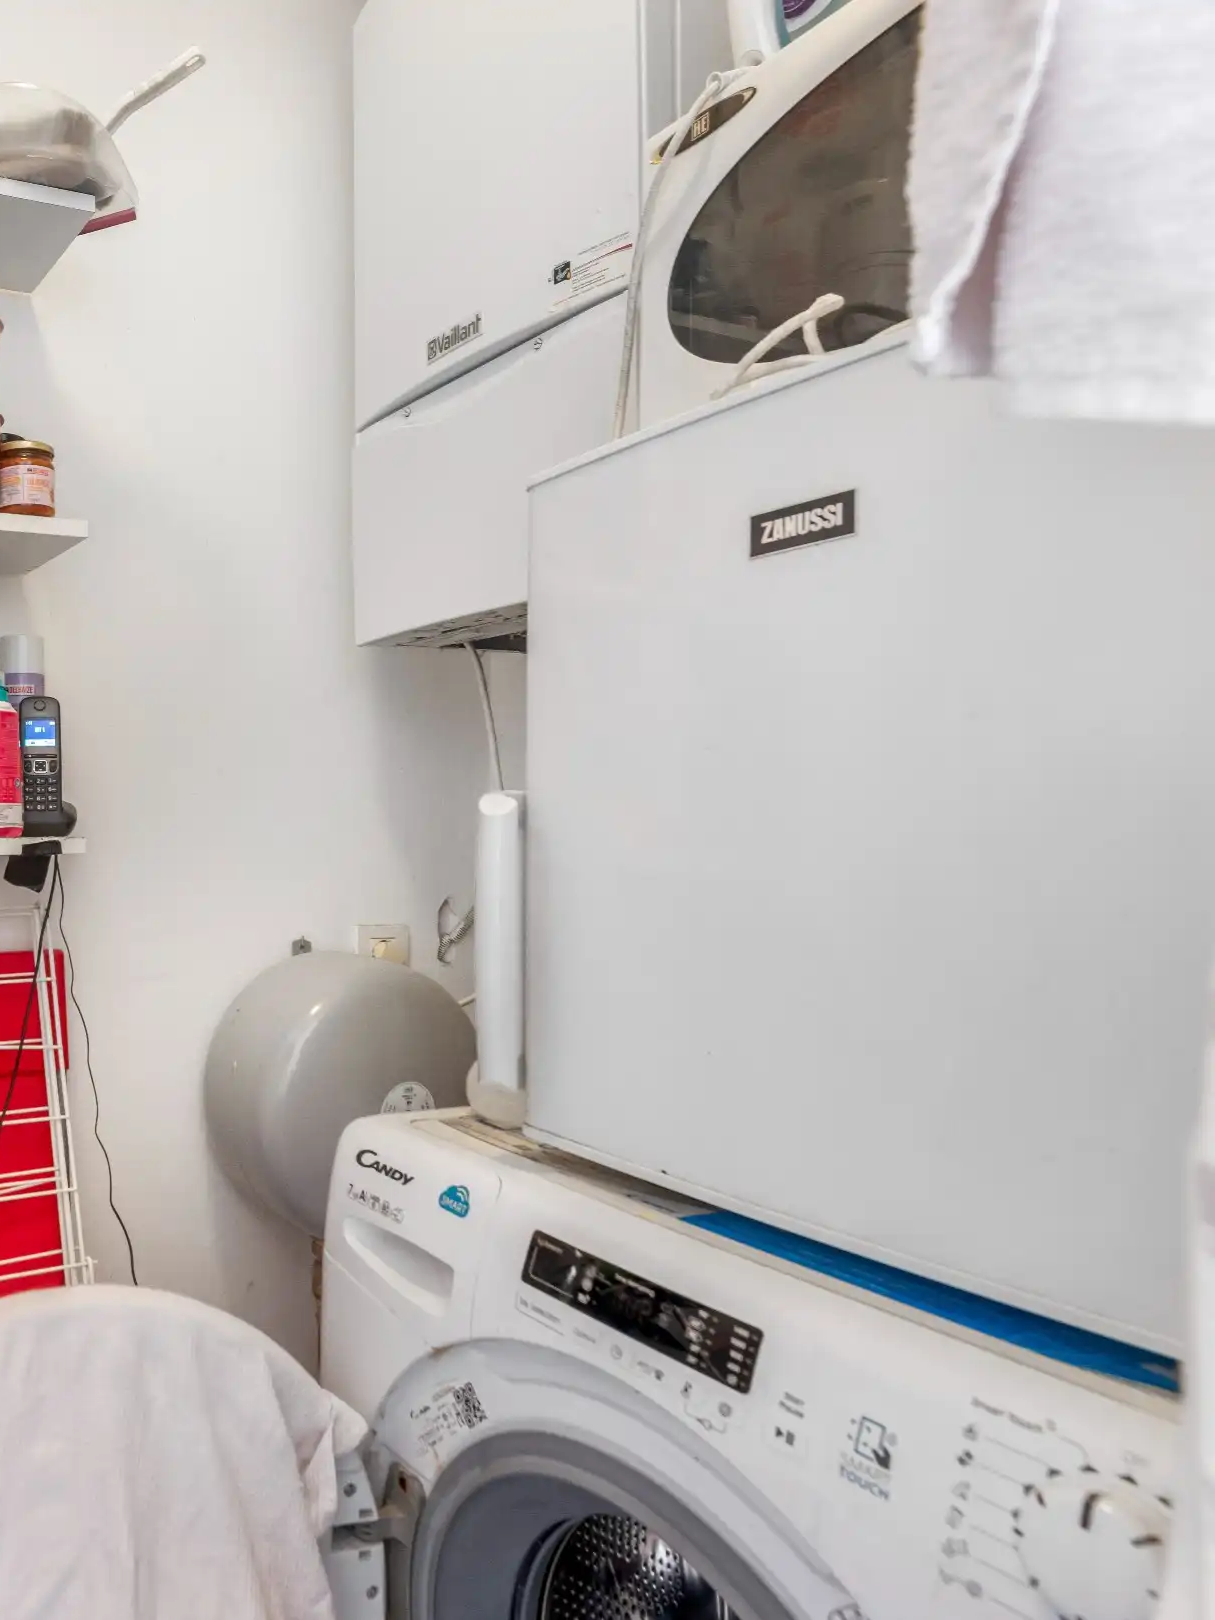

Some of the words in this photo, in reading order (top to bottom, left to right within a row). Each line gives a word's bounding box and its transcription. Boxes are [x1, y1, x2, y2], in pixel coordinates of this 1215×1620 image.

[436, 314, 482, 355] Vaillant
[761, 502, 844, 544] ZANUSSI
[356, 1149, 415, 1186] CANDY
